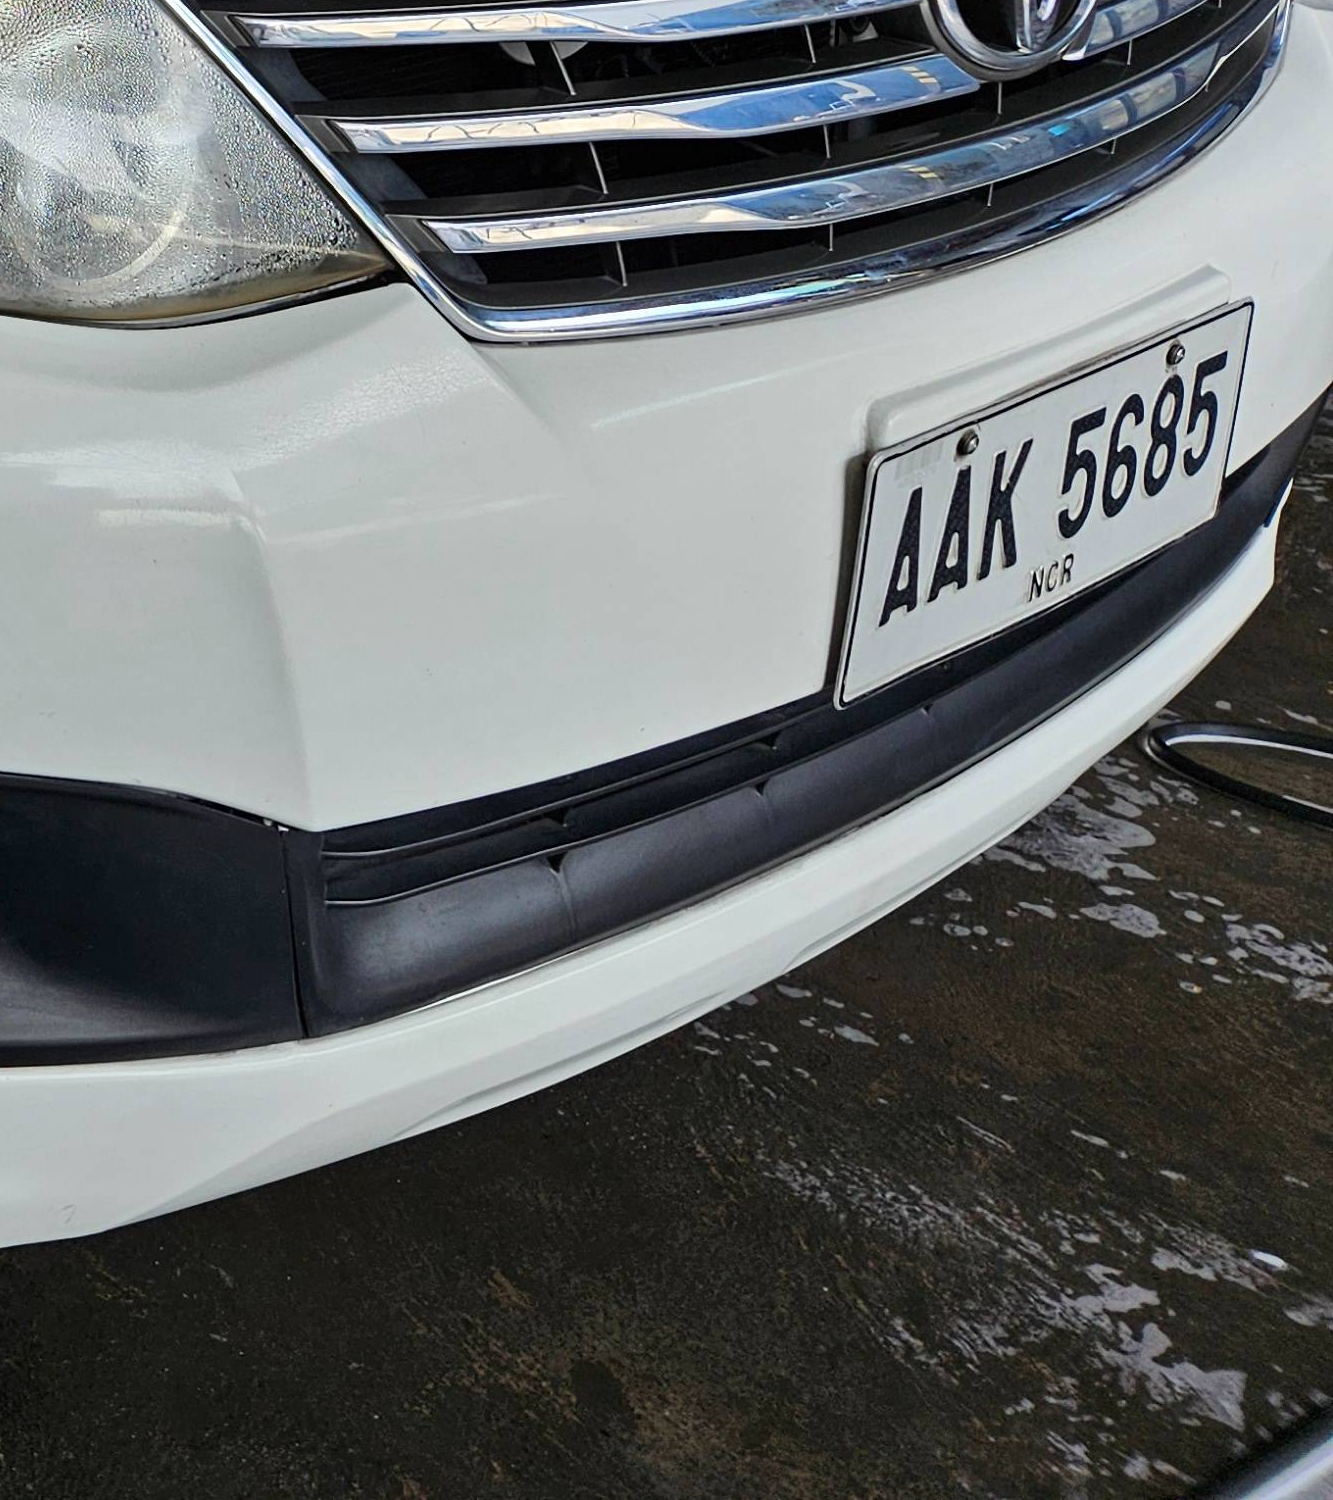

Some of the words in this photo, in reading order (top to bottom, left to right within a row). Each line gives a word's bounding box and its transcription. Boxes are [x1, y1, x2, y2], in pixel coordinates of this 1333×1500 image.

[877, 437, 1034, 629] AAK
[1057, 350, 1229, 540] 5685
[1028, 553, 1075, 604] NCR
